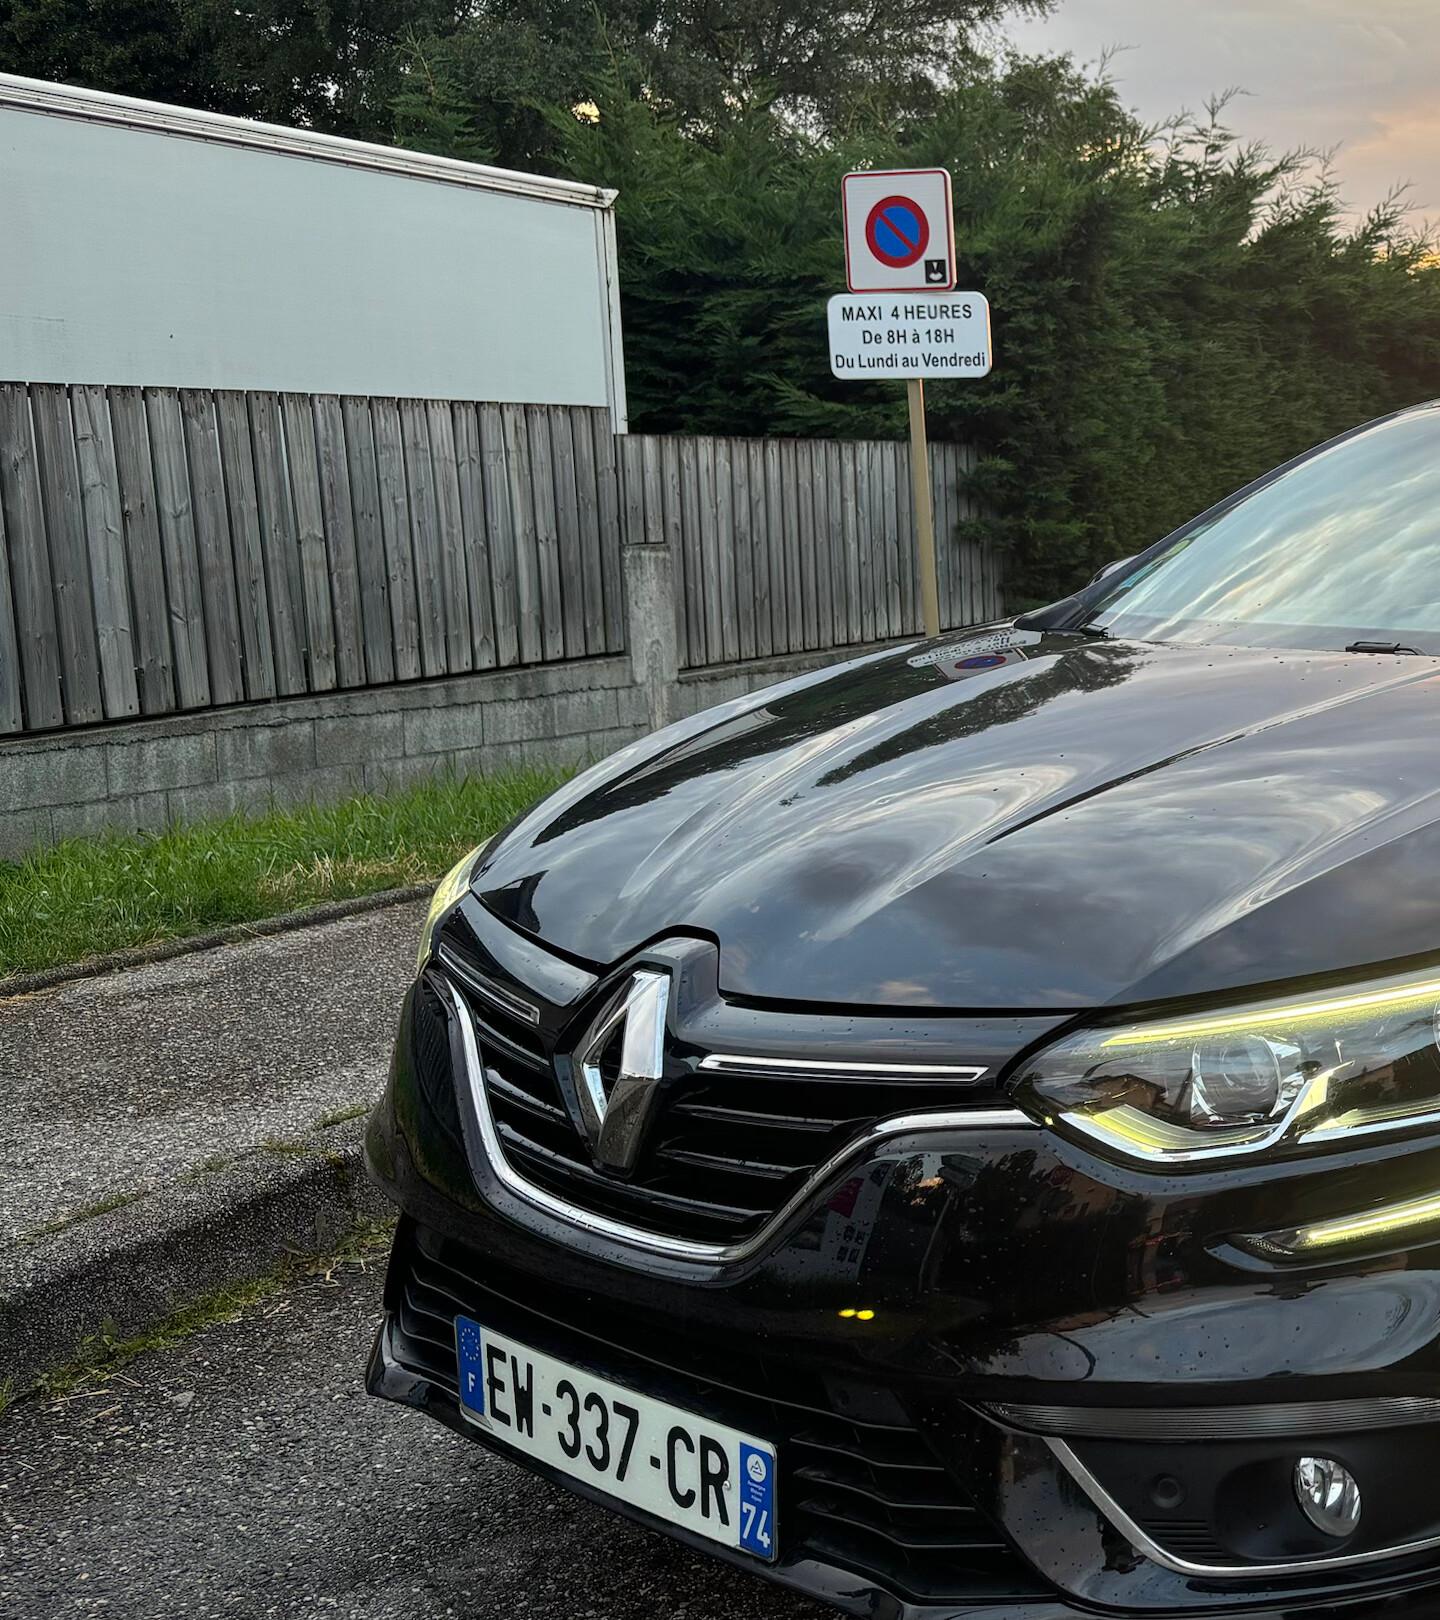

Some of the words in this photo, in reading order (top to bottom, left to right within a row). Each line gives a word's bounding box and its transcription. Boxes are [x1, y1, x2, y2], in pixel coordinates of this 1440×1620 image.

[842, 306, 882, 321] MAXI
[891, 306, 900, 320] 4
[904, 304, 973, 320] HEURES
[862, 330, 882, 345] De
[887, 329, 907, 344] 8H
[912, 329, 920, 343] à
[925, 329, 955, 343] 18H
[835, 354, 854, 368] Du
[858, 353, 898, 368] Lundi
[902, 356, 919, 368] au
[922, 352, 985, 368] Vendredi
[467, 1371, 476, 1393] F
[485, 1343, 730, 1527] EW-337-CR
[742, 1501, 771, 1549] 74
